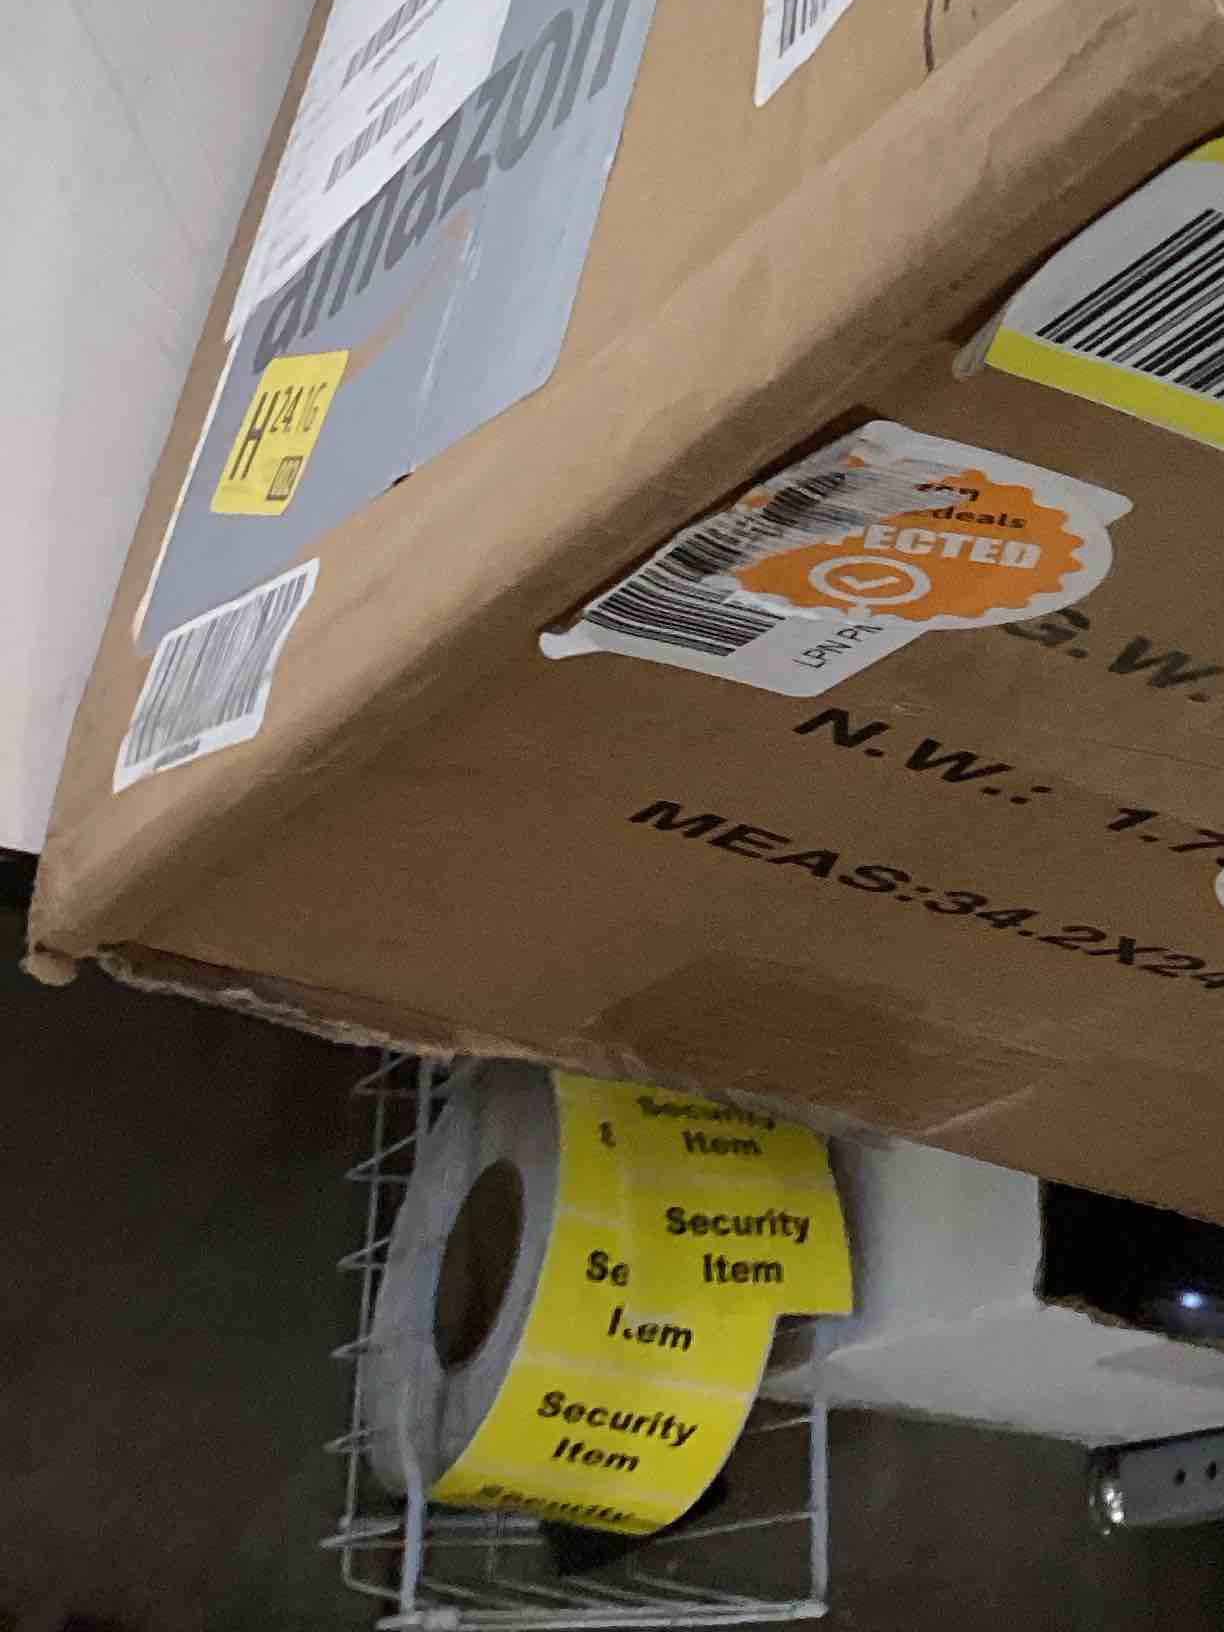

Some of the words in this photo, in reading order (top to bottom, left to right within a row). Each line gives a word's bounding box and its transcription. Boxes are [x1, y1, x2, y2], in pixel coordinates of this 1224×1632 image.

[228, 390, 281, 481] H
[792, 639, 852, 669] LPN
[793, 707, 1052, 805] N.W.:
[681, 1129, 763, 1156] Item
[665, 1205, 811, 1245] Security
[703, 1252, 785, 1284] Item
[537, 1390, 698, 1447] Security
[552, 1437, 641, 1473] Item
